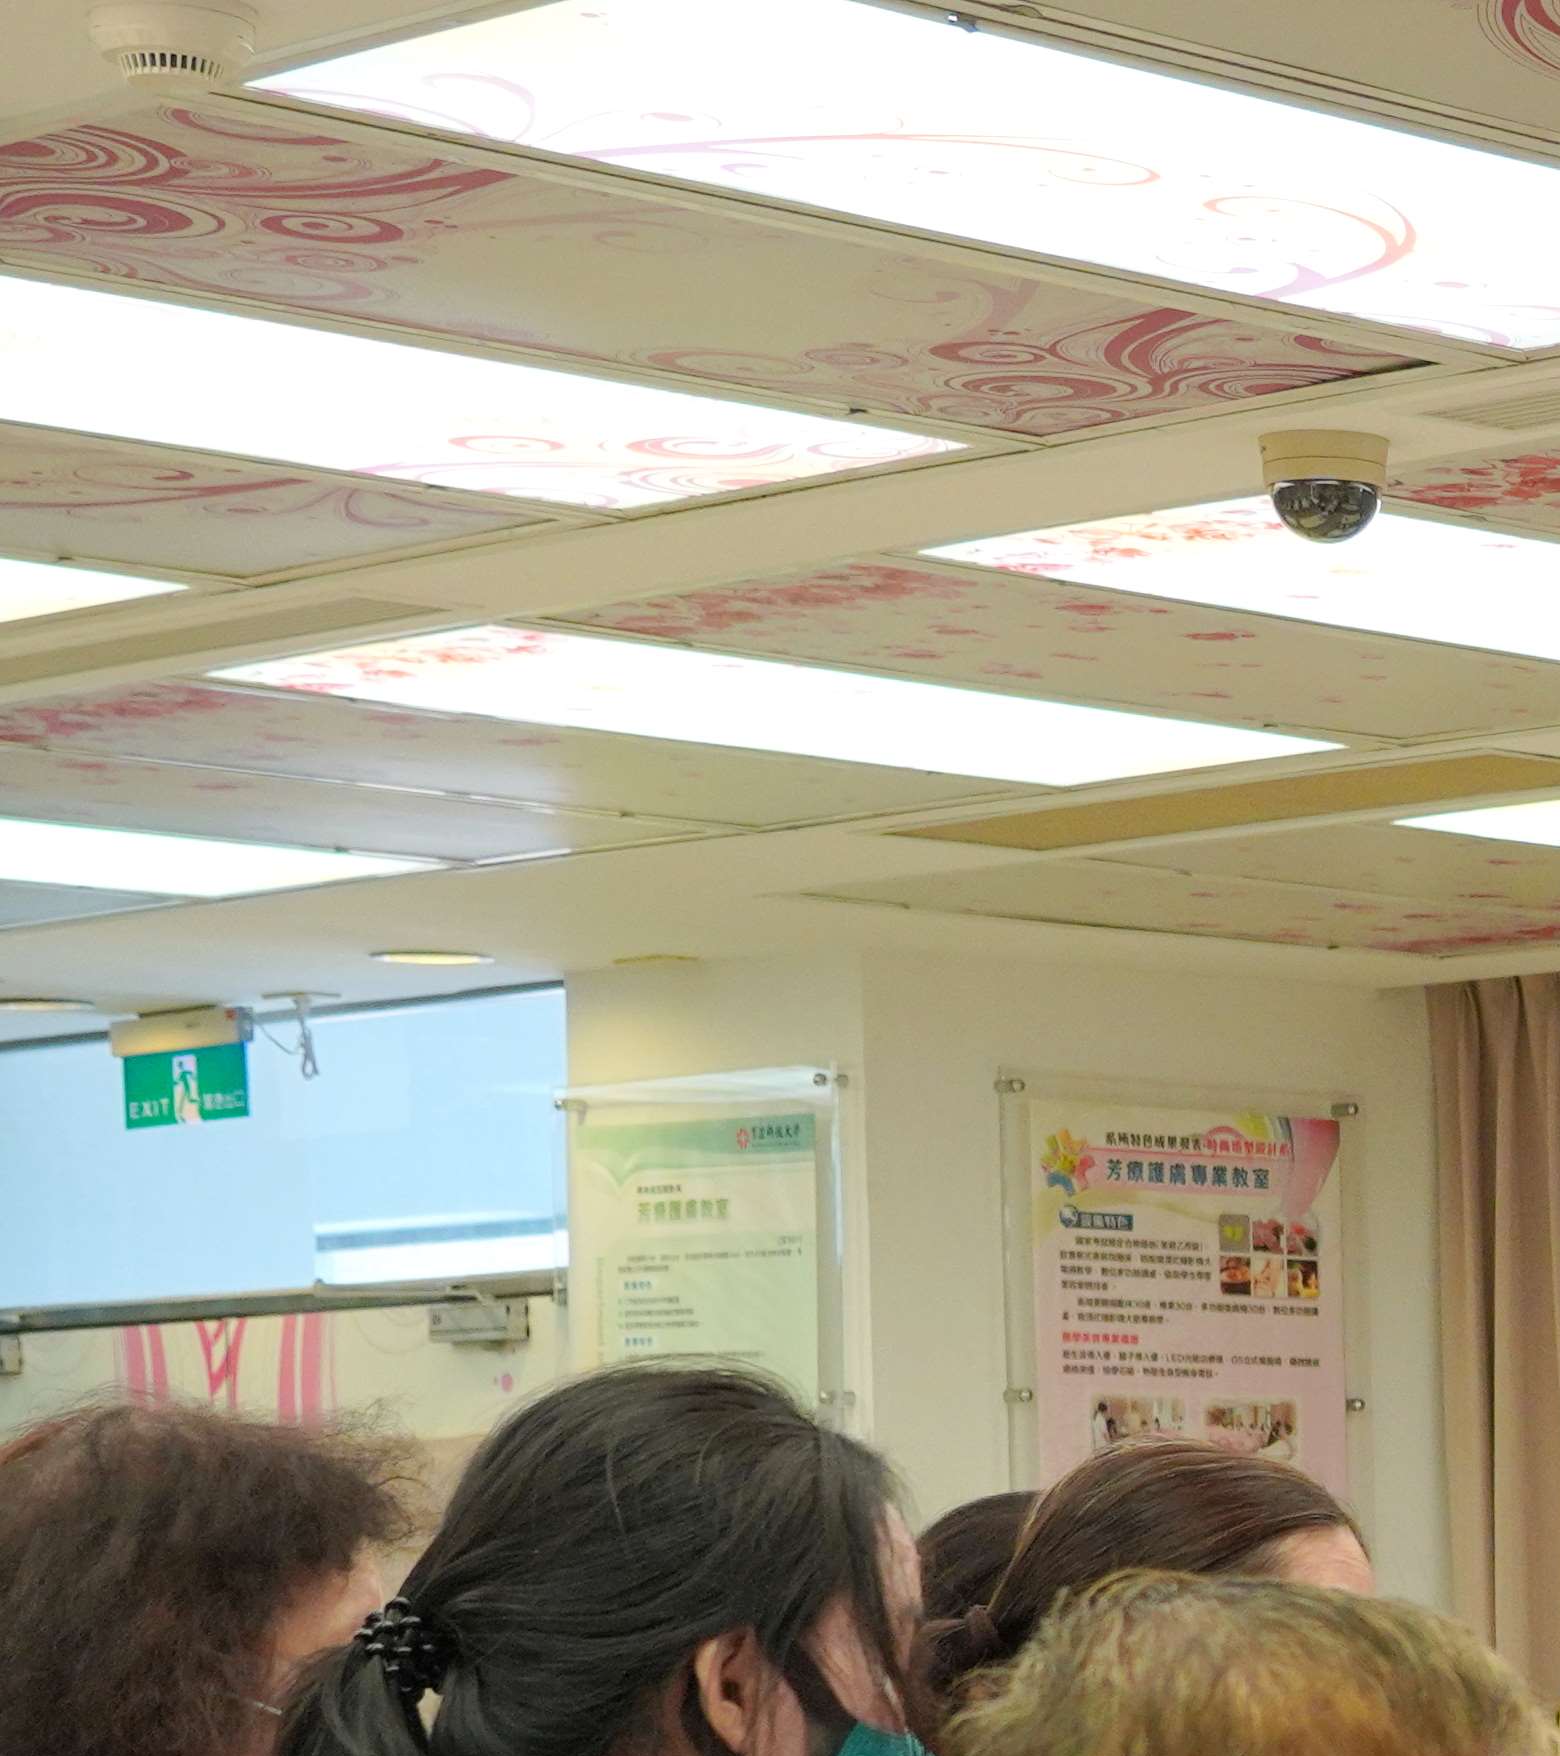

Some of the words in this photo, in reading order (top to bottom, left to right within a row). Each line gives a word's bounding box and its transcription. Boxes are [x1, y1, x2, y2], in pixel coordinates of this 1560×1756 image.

[129, 1098, 170, 1120] EXIT
[1106, 1159, 1270, 1189] 芳療護膚專業教室
